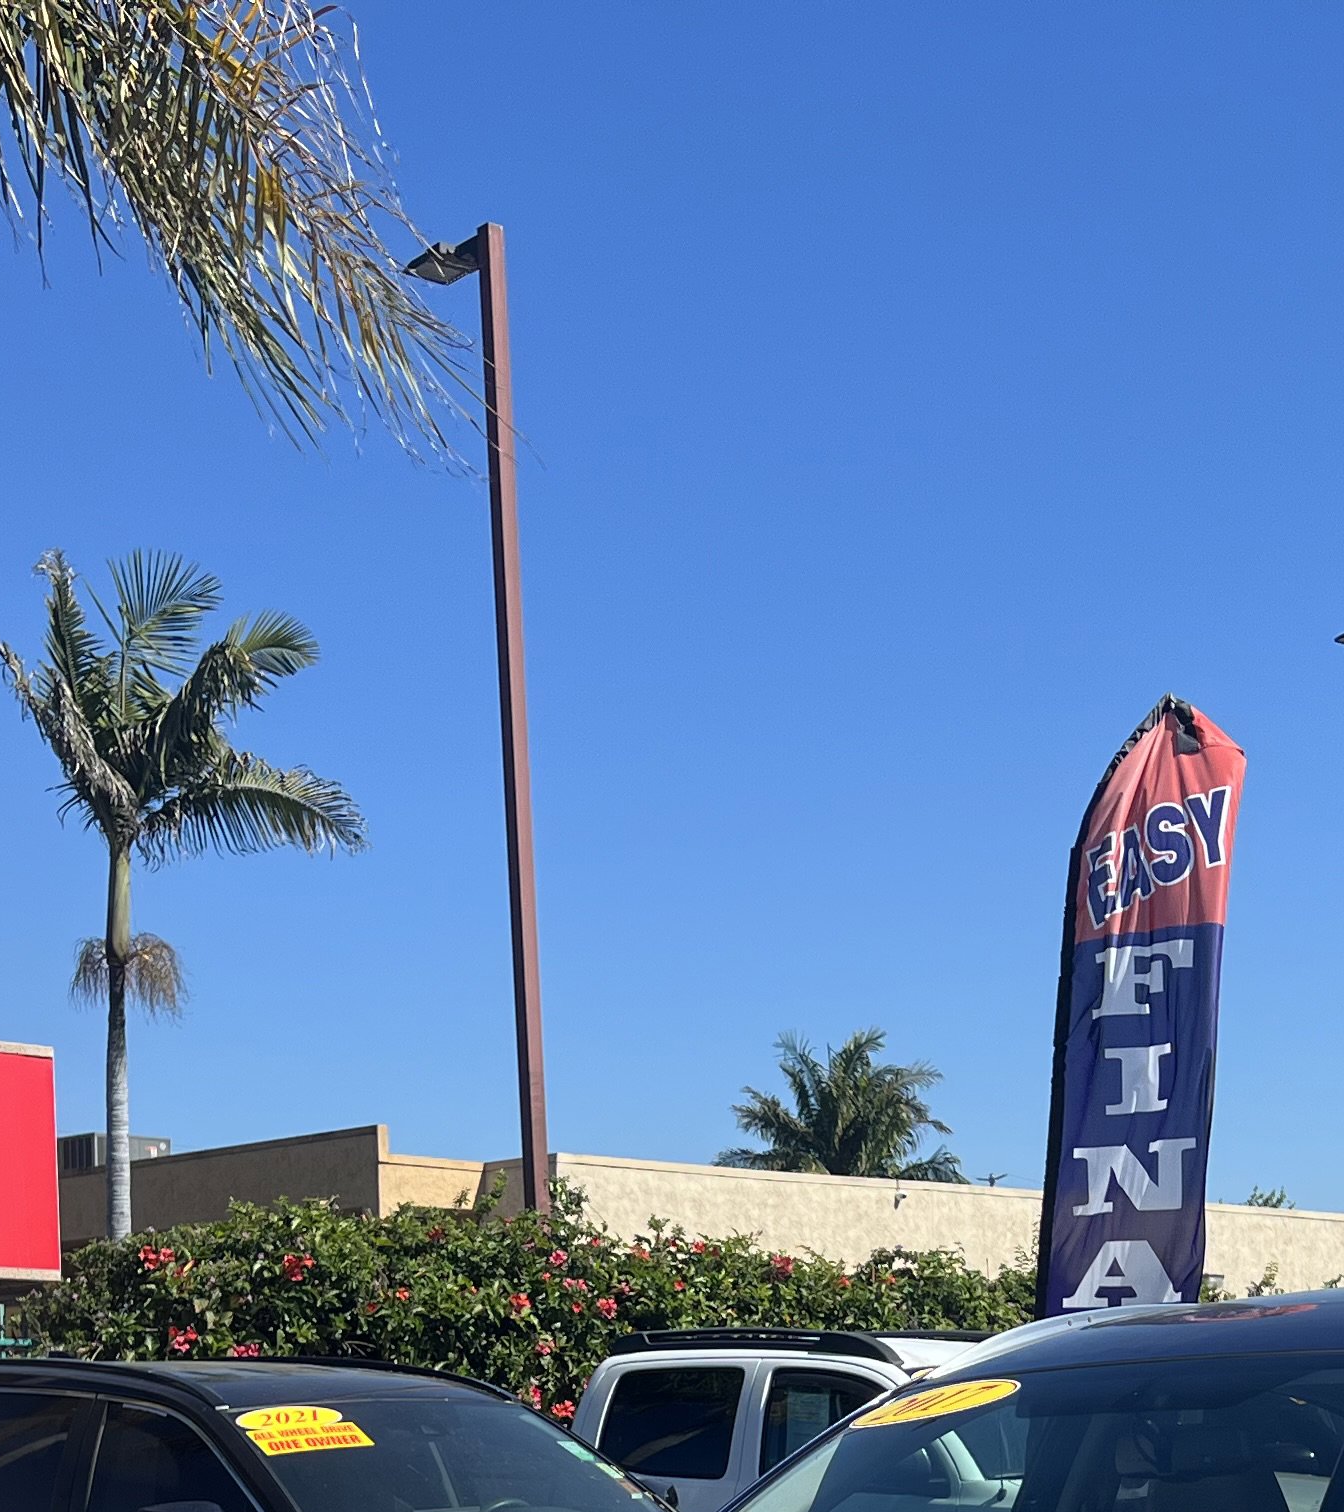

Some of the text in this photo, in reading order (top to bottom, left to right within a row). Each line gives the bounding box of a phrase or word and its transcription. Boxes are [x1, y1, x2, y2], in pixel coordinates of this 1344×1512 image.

[1087, 785, 1233, 930] EASY
[260, 1410, 318, 1426] 2021
[253, 1424, 354, 1441] ALL WHEEL DRIVE
[268, 1434, 362, 1452] ONE OWNER
